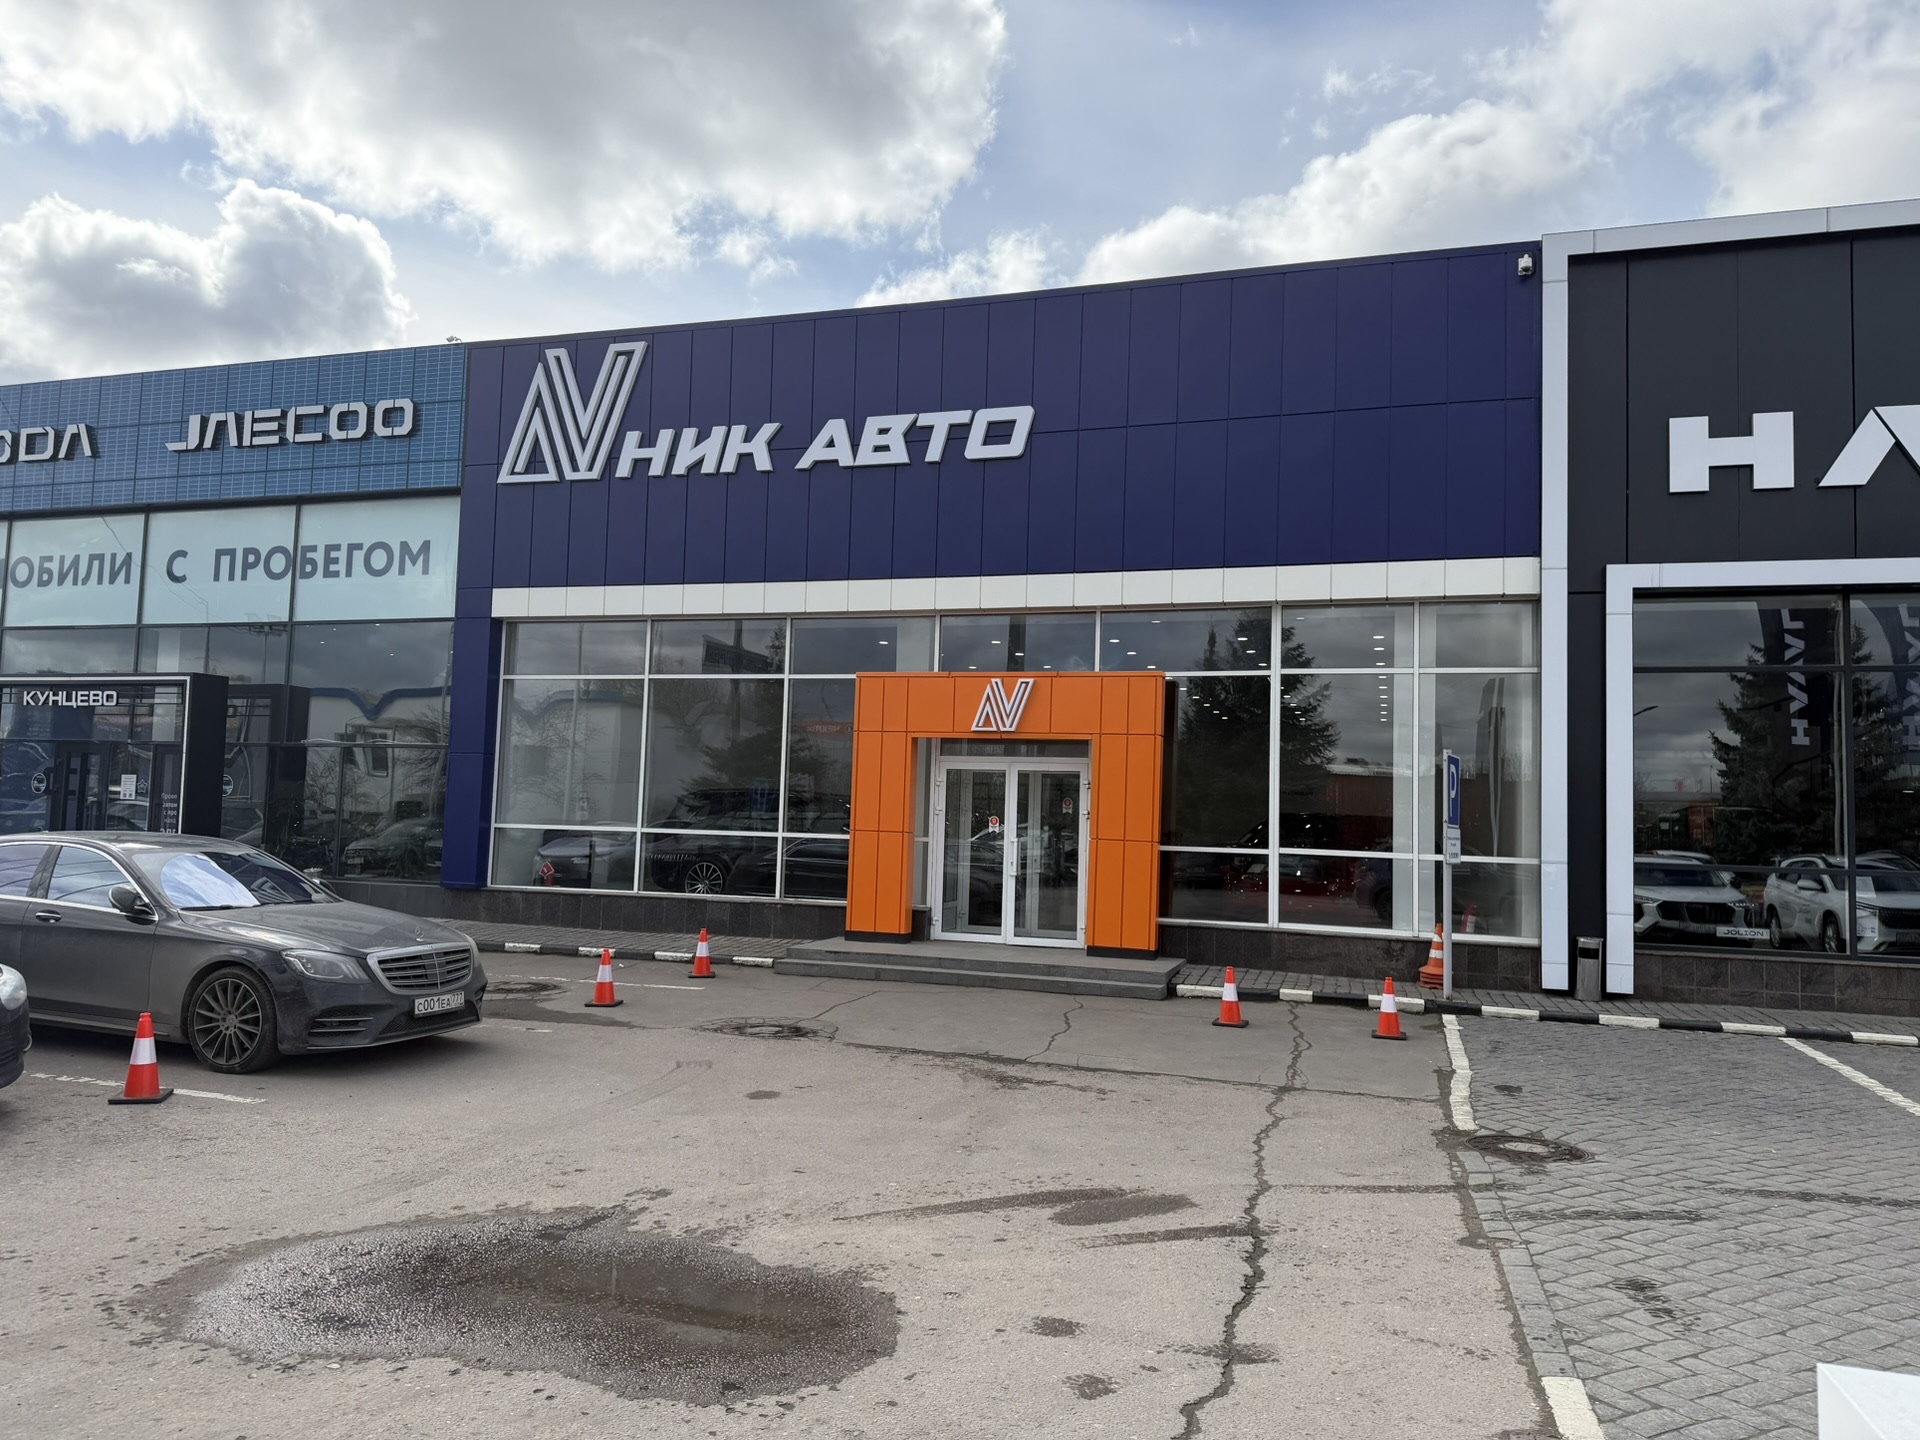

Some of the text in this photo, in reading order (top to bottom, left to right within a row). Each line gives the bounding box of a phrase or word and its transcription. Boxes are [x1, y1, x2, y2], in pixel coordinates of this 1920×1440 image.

[165, 398, 414, 452] JAECOO
[615, 422, 782, 478] НИК
[794, 405, 1036, 470] АВТО
[166, 549, 188, 584] С
[213, 540, 431, 582] ПРОБЕГОМ
[22, 690, 118, 709] КУНЦЕВО
[1449, 763, 1457, 816] P
[1723, 929, 1764, 937] JOLION
